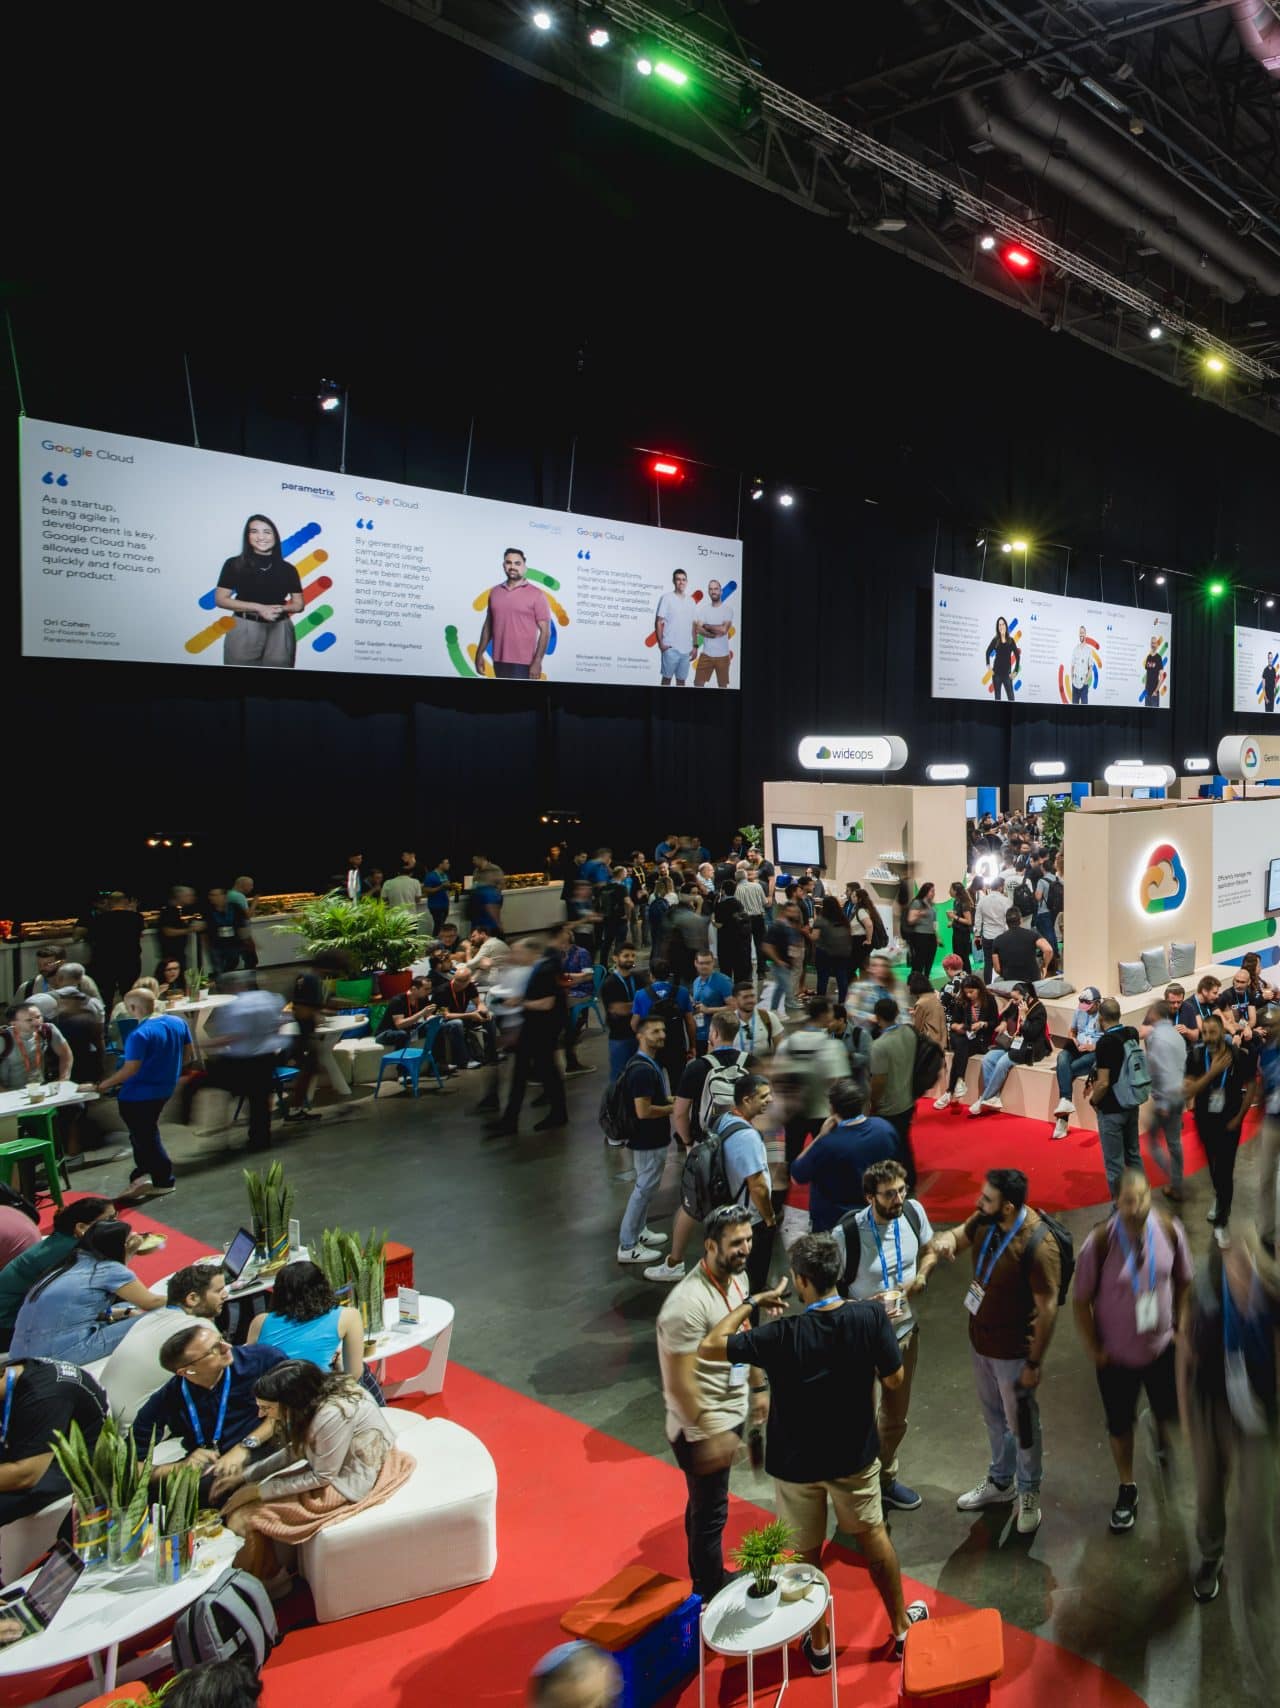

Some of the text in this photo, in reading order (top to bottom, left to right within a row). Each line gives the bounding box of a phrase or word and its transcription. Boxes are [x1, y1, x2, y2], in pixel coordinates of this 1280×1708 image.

[41, 439, 134, 464] Google Cloud
[281, 482, 335, 497] parametrix
[42, 494, 58, 504] As
[355, 491, 419, 510] Google Cloud
[42, 507, 120, 524] being agile in
[42, 519, 120, 535] development
[123, 528, 133, 537] is
[42, 530, 146, 550] Google Cloud has
[42, 543, 154, 562] allowed us to move
[42, 555, 160, 574] quickly and focus on
[42, 567, 63, 576] our
[832, 747, 873, 763] wideops
